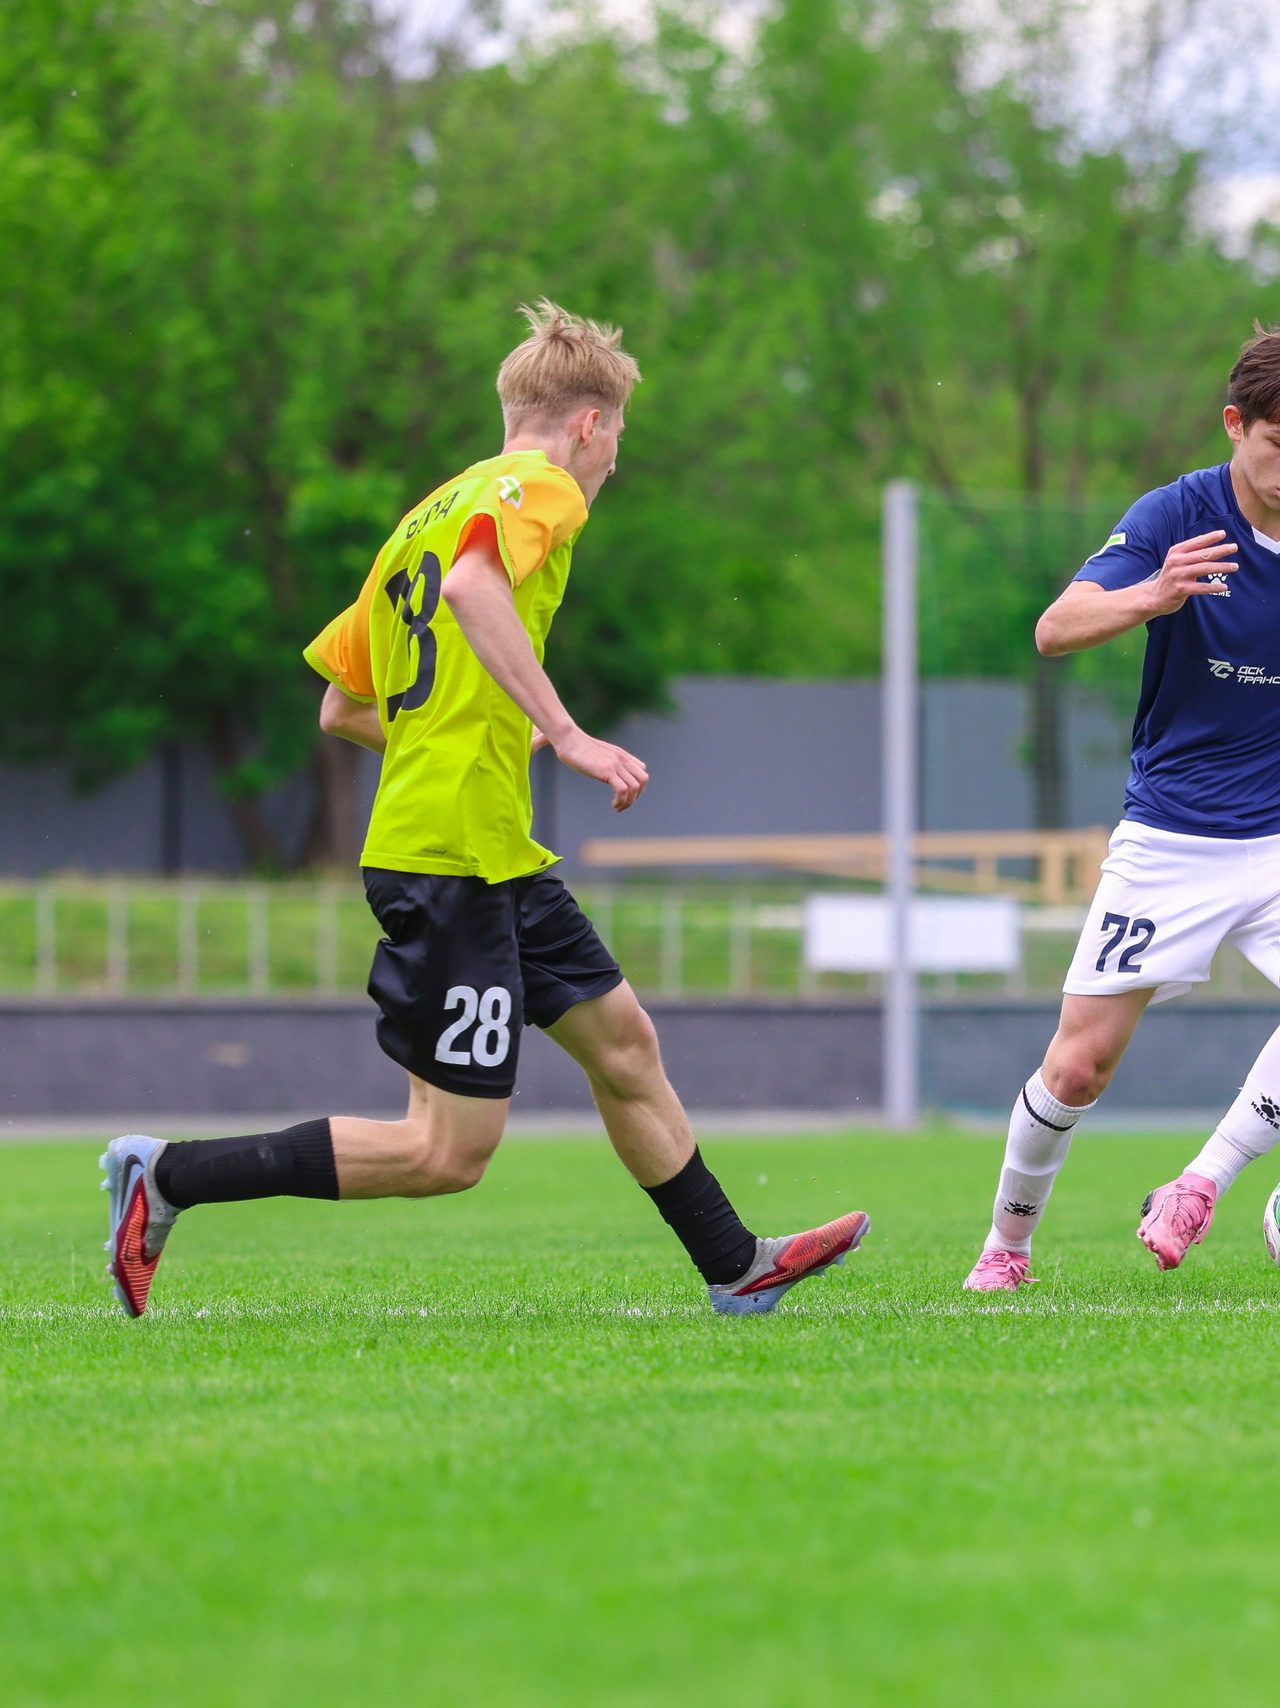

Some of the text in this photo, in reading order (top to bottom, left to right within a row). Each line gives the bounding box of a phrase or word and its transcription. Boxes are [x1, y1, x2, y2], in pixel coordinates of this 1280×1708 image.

[1237, 665, 1266, 676] ДСК
[1095, 911, 1156, 974] 72
[434, 985, 512, 1068] 28
[1250, 1101, 1280, 1130] KELME
